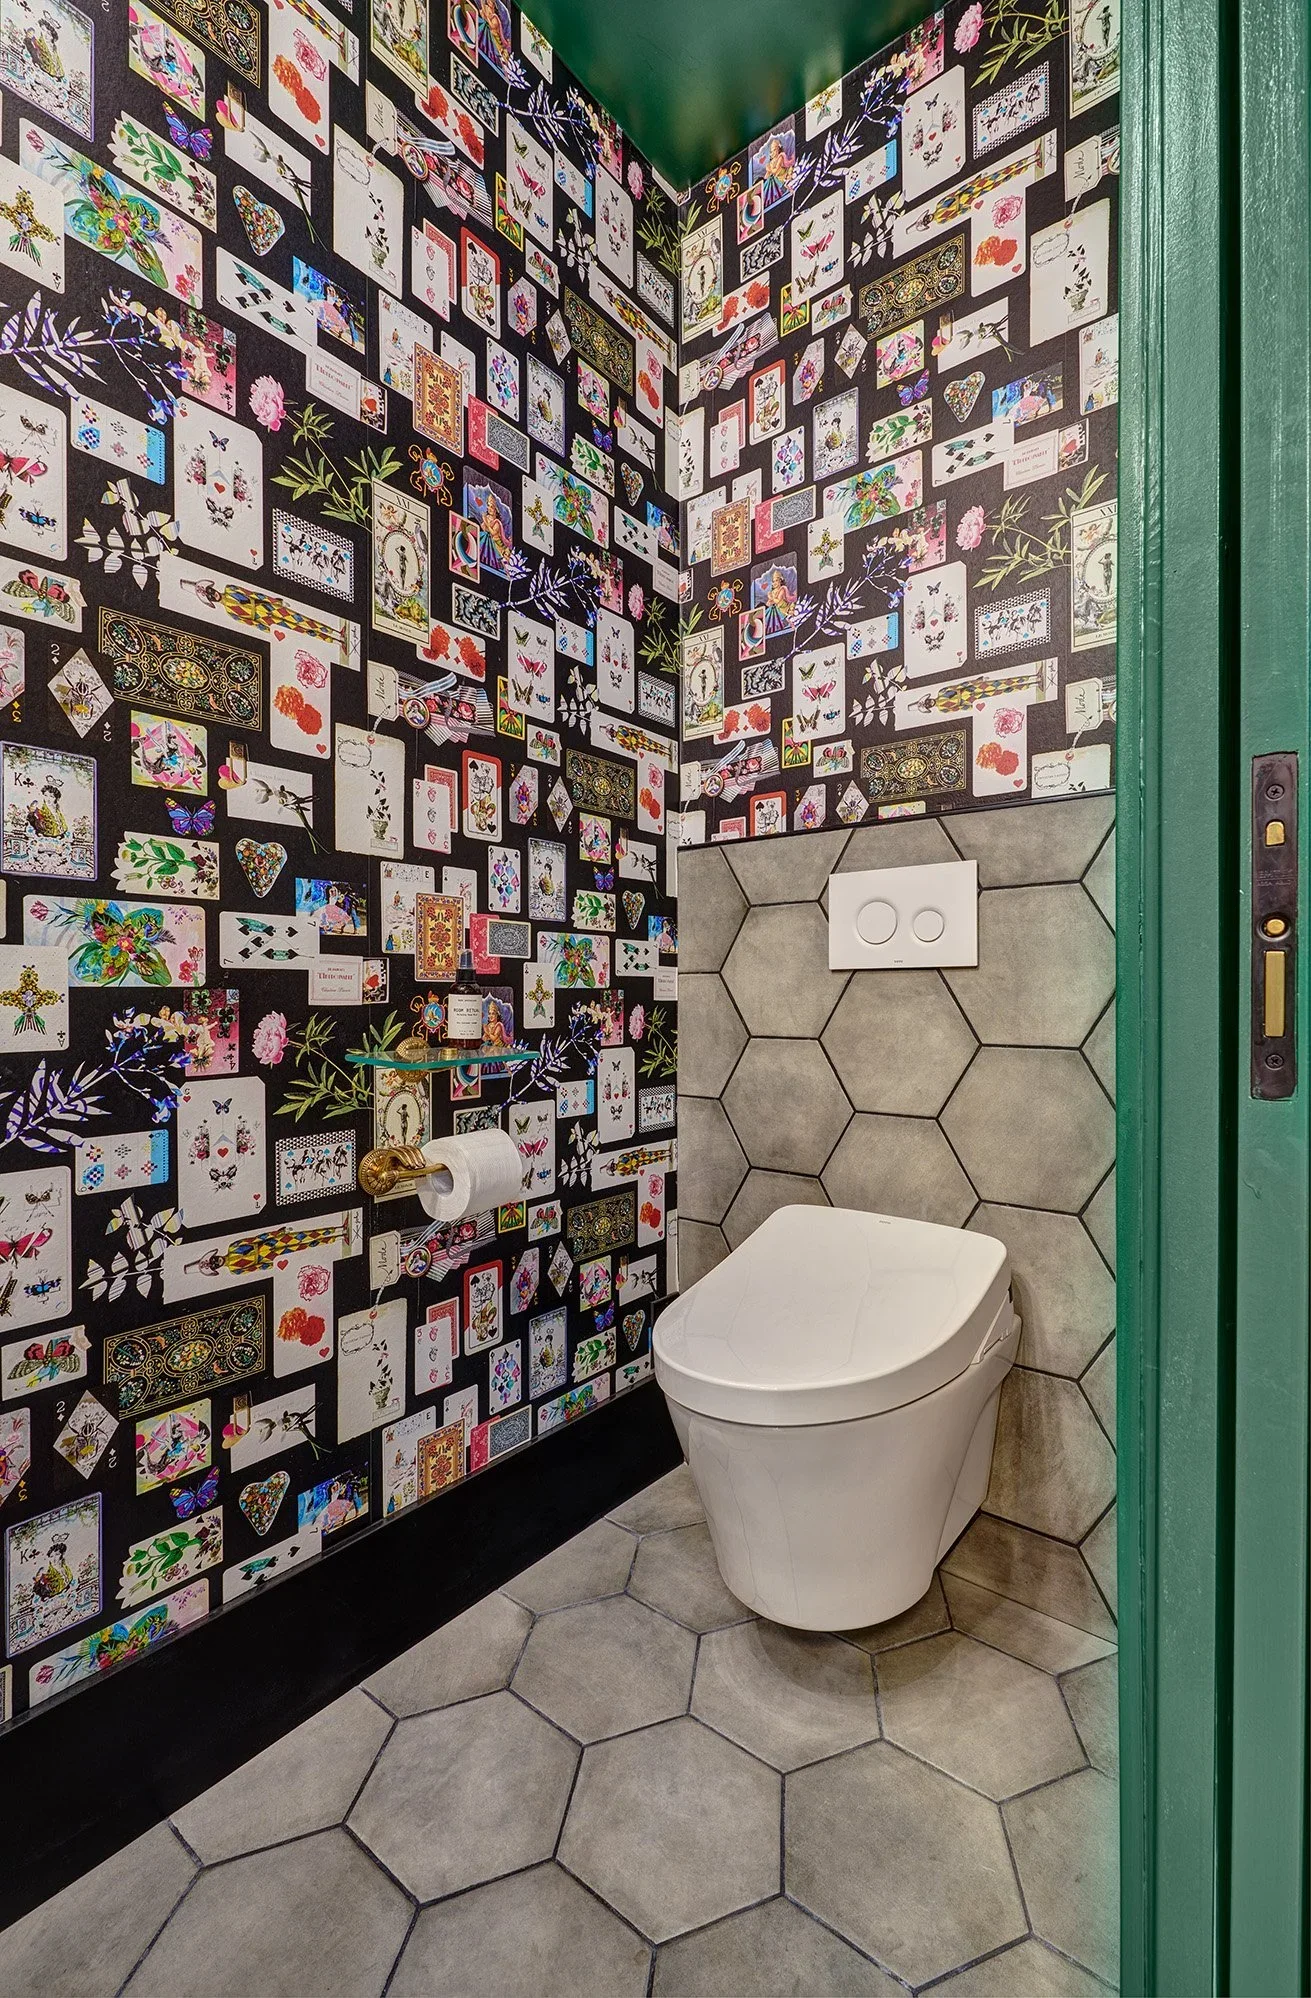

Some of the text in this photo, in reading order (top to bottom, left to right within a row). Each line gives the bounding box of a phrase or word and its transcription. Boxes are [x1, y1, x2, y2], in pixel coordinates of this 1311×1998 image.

[50, 643, 60, 656] 2
[12, 710, 22, 723] 3
[103, 730, 112, 742] 2
[14, 772, 23, 787] K
[415, 781, 421, 790] 3
[57, 1038, 66, 1048] A
[229, 1060, 236, 1071] 4
[416, 1328, 423, 1338] 3
[56, 1401, 66, 1413] 2
[108, 1456, 118, 1469] 2
[18, 1489, 28, 1502] 3
[20, 1549, 29, 1565] K
